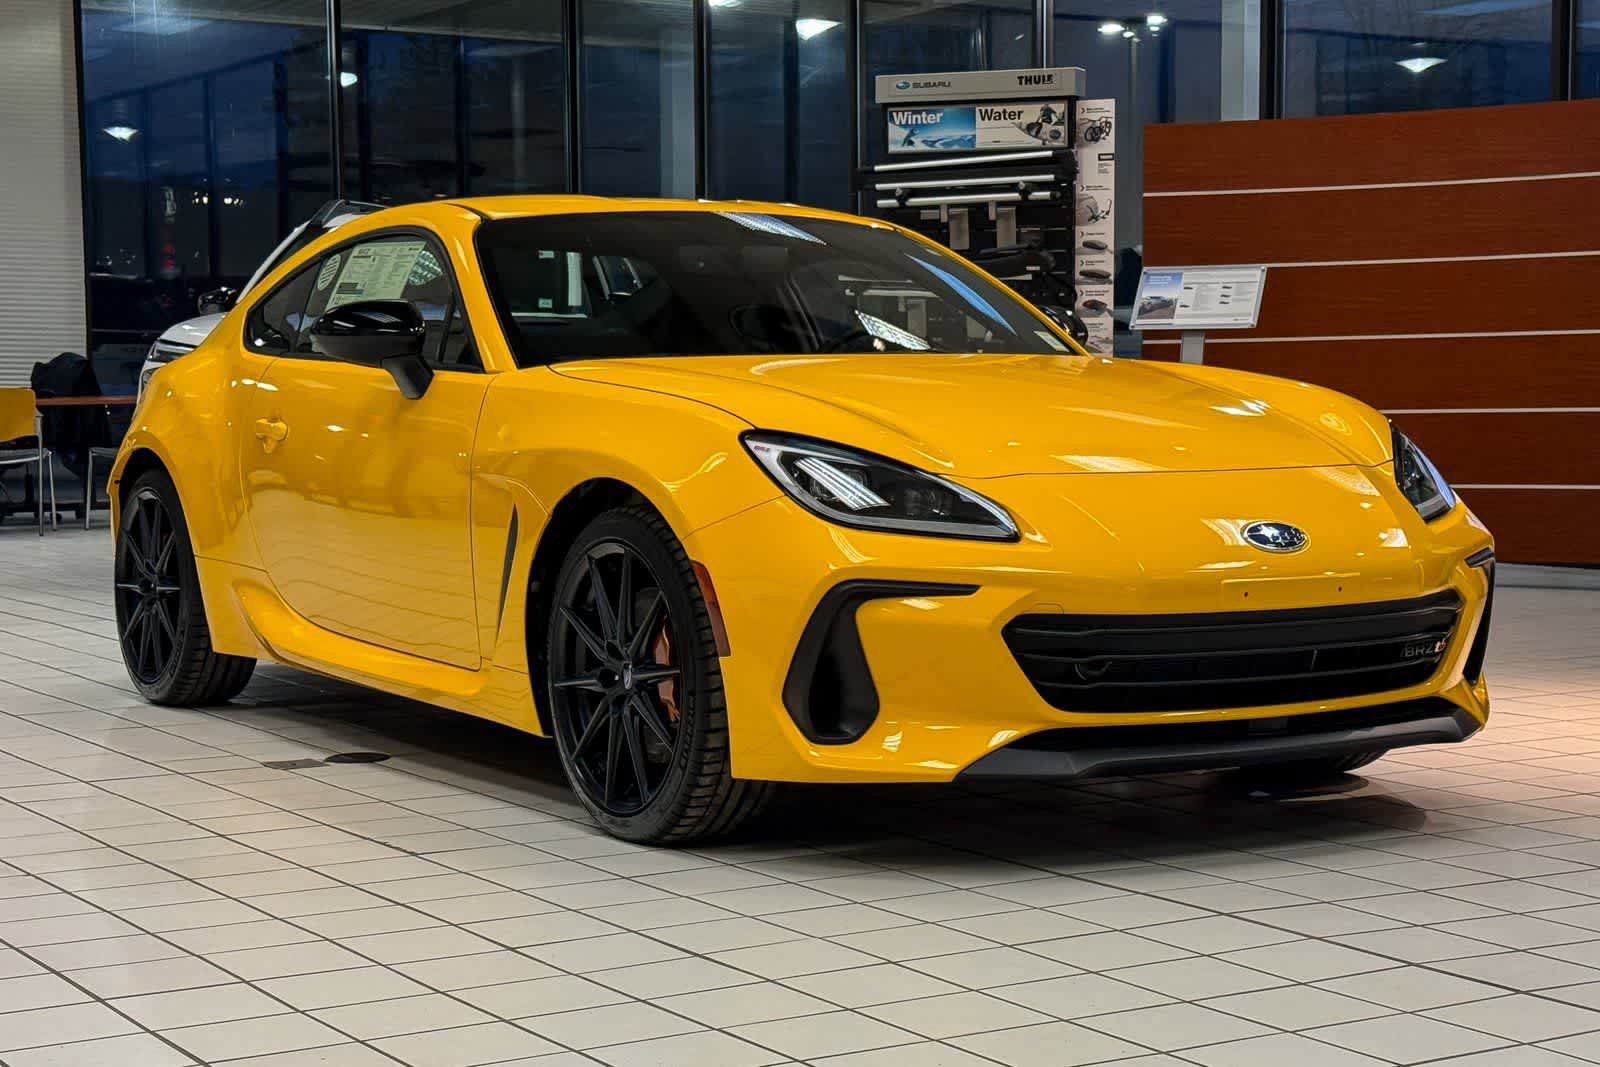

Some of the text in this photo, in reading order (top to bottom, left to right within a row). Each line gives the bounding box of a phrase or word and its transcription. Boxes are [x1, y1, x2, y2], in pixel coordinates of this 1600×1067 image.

[912, 80, 951, 89] SUBARU
[1017, 73, 1054, 86] THULE
[892, 111, 943, 125] Winter
[979, 108, 1024, 122] Water
[1404, 643, 1433, 657] BRZ
